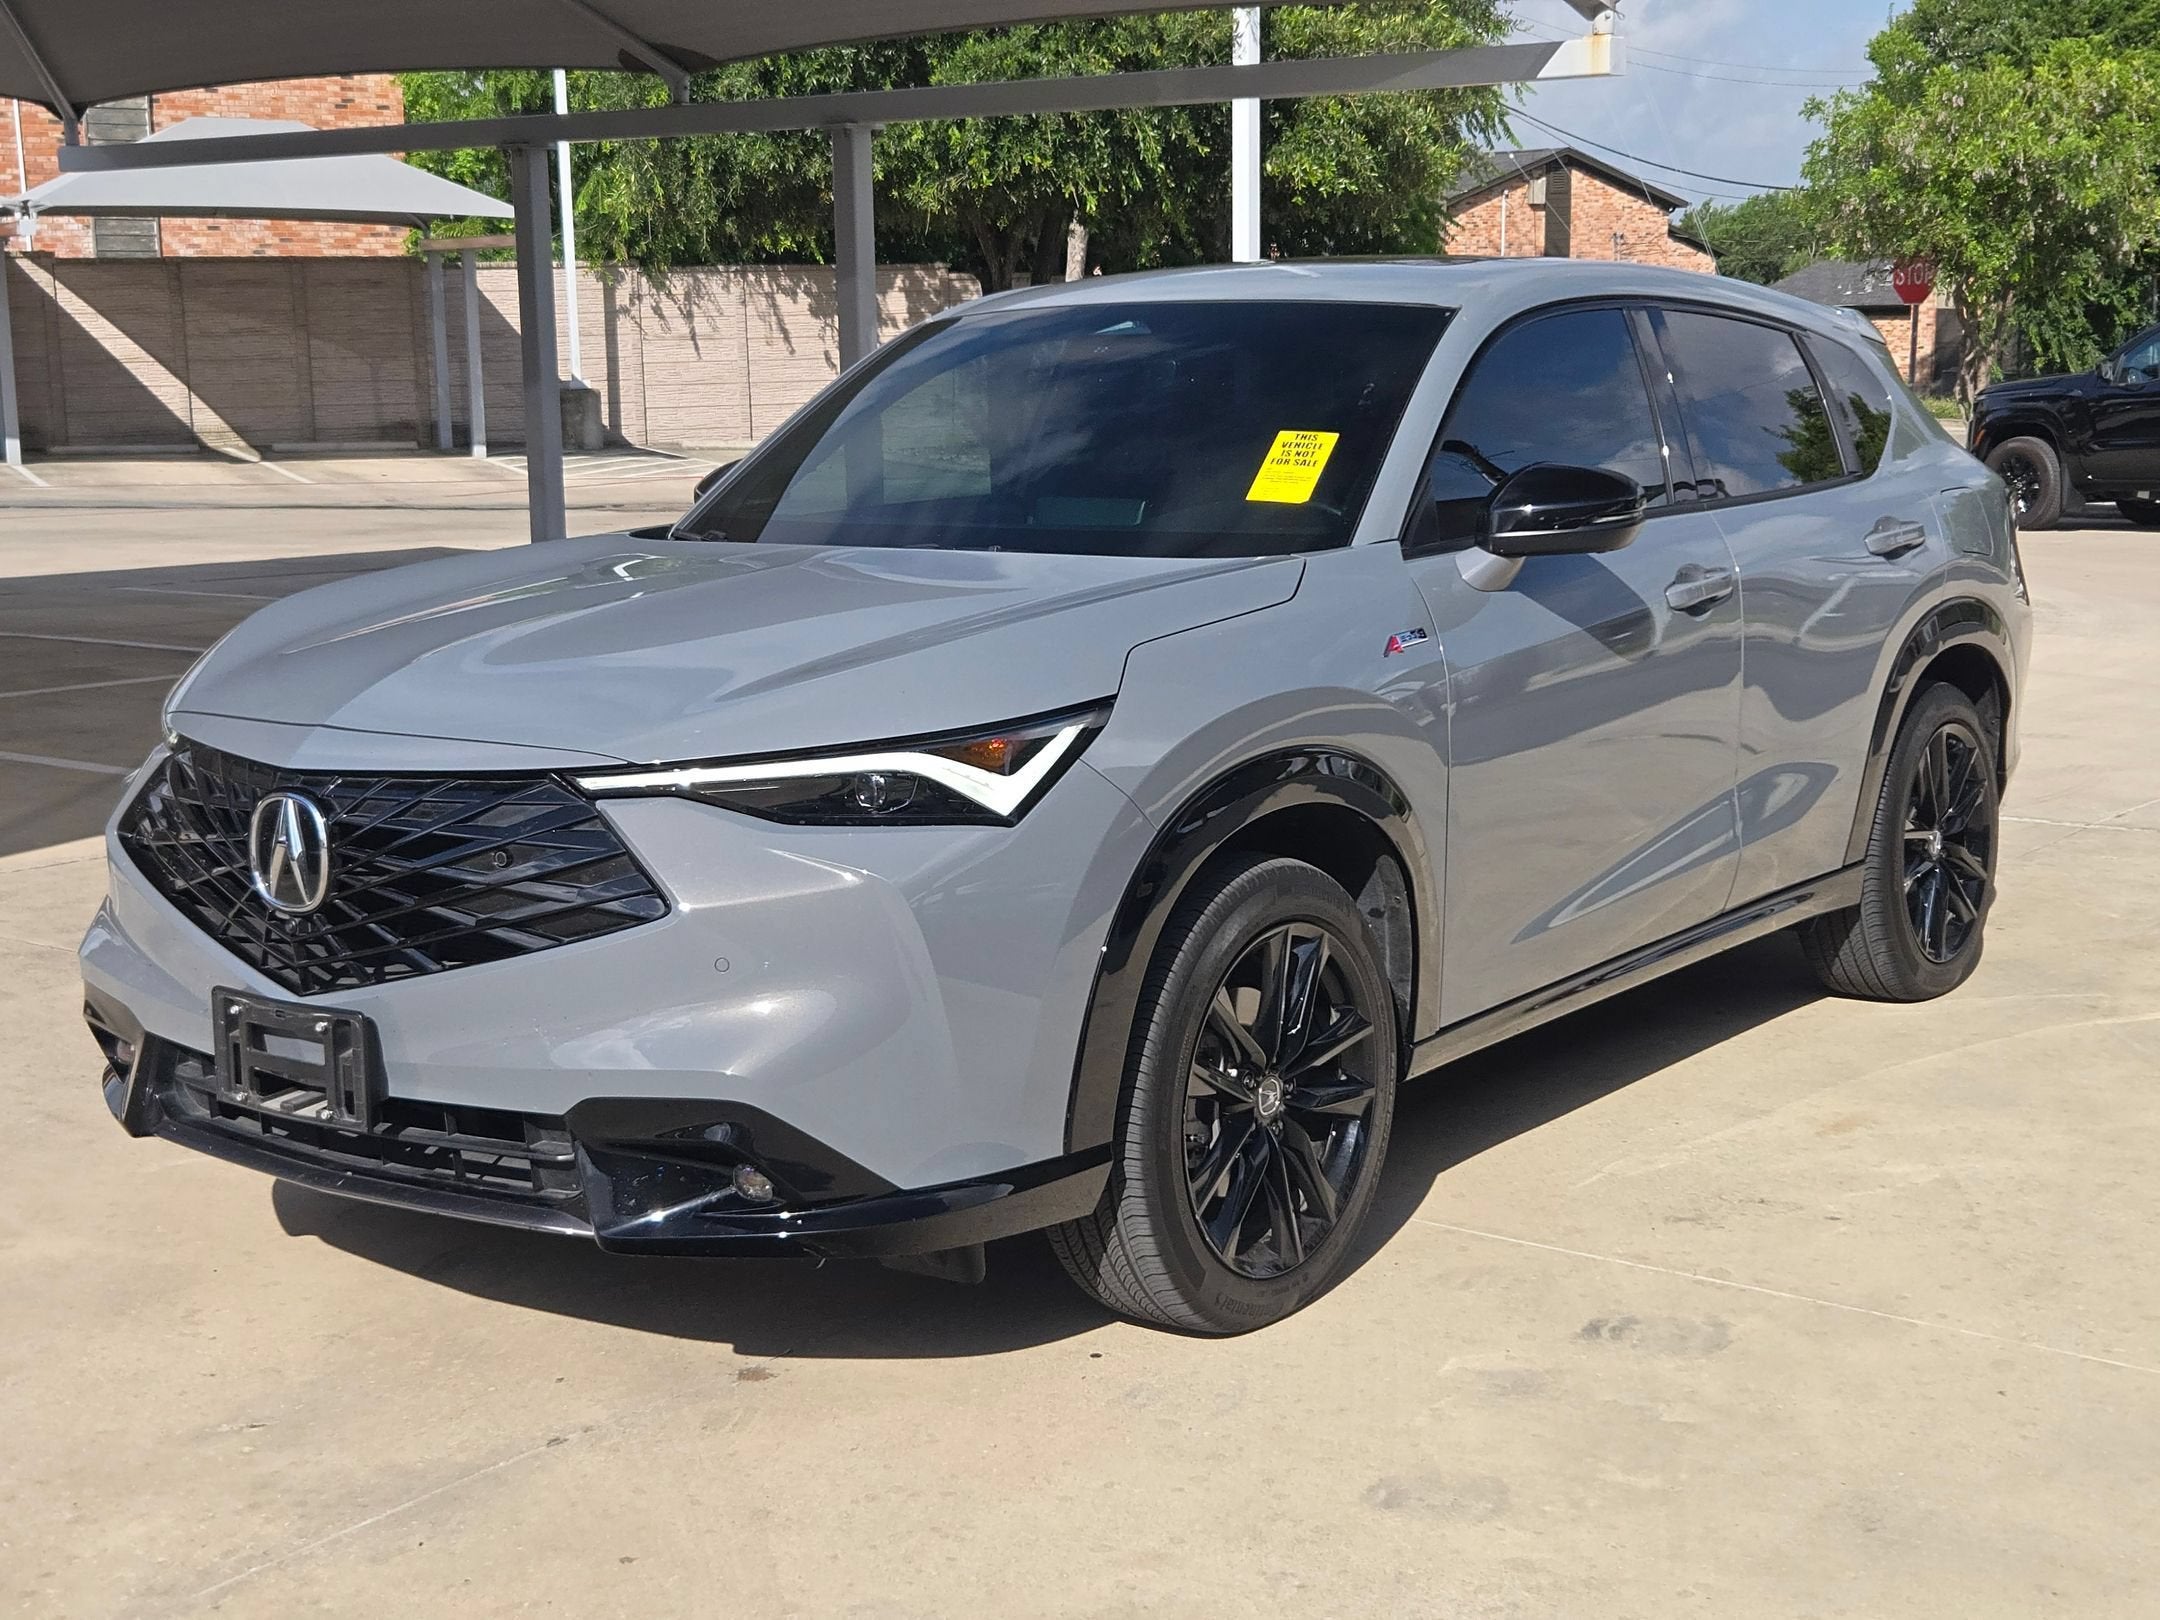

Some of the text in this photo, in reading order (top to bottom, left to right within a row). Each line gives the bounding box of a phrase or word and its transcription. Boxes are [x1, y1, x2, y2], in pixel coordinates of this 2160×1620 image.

[1895, 262, 1934, 285] STOP
[1294, 433, 1319, 442] THIS
[1281, 441, 1324, 450] VEHICLE
[1280, 449, 1316, 458] IS NOT
[1270, 457, 1318, 467] FOR SALE
